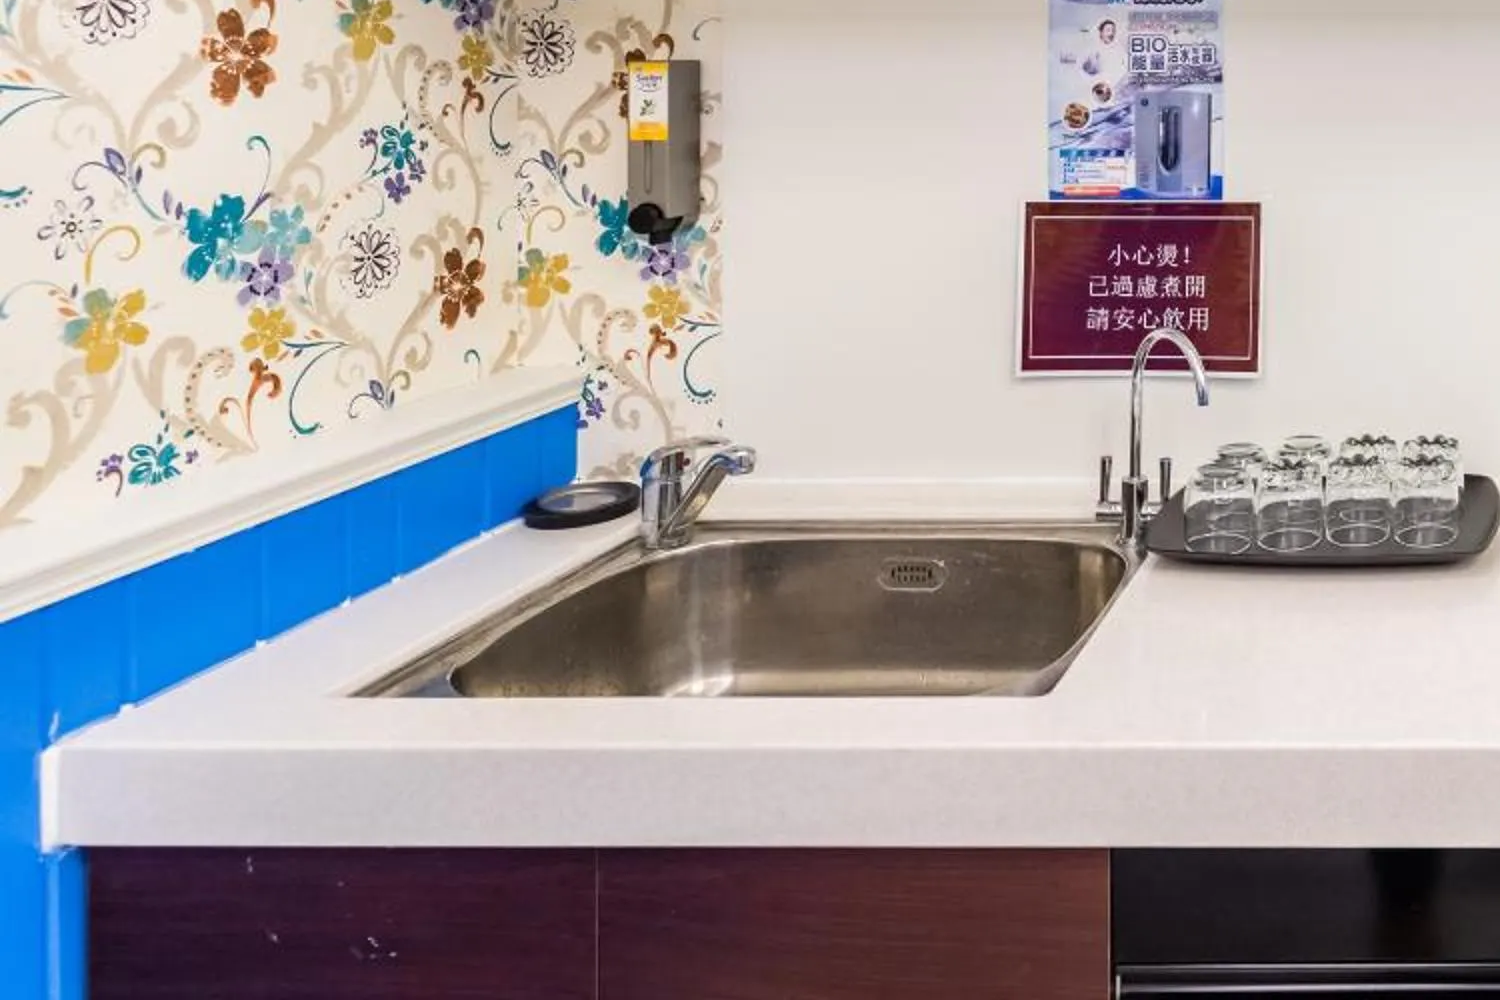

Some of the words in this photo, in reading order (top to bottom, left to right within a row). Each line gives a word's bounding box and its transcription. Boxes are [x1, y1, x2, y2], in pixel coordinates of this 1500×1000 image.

[1131, 37, 1167, 53] BIO
[1085, 306, 1209, 331] 請安心飲用
